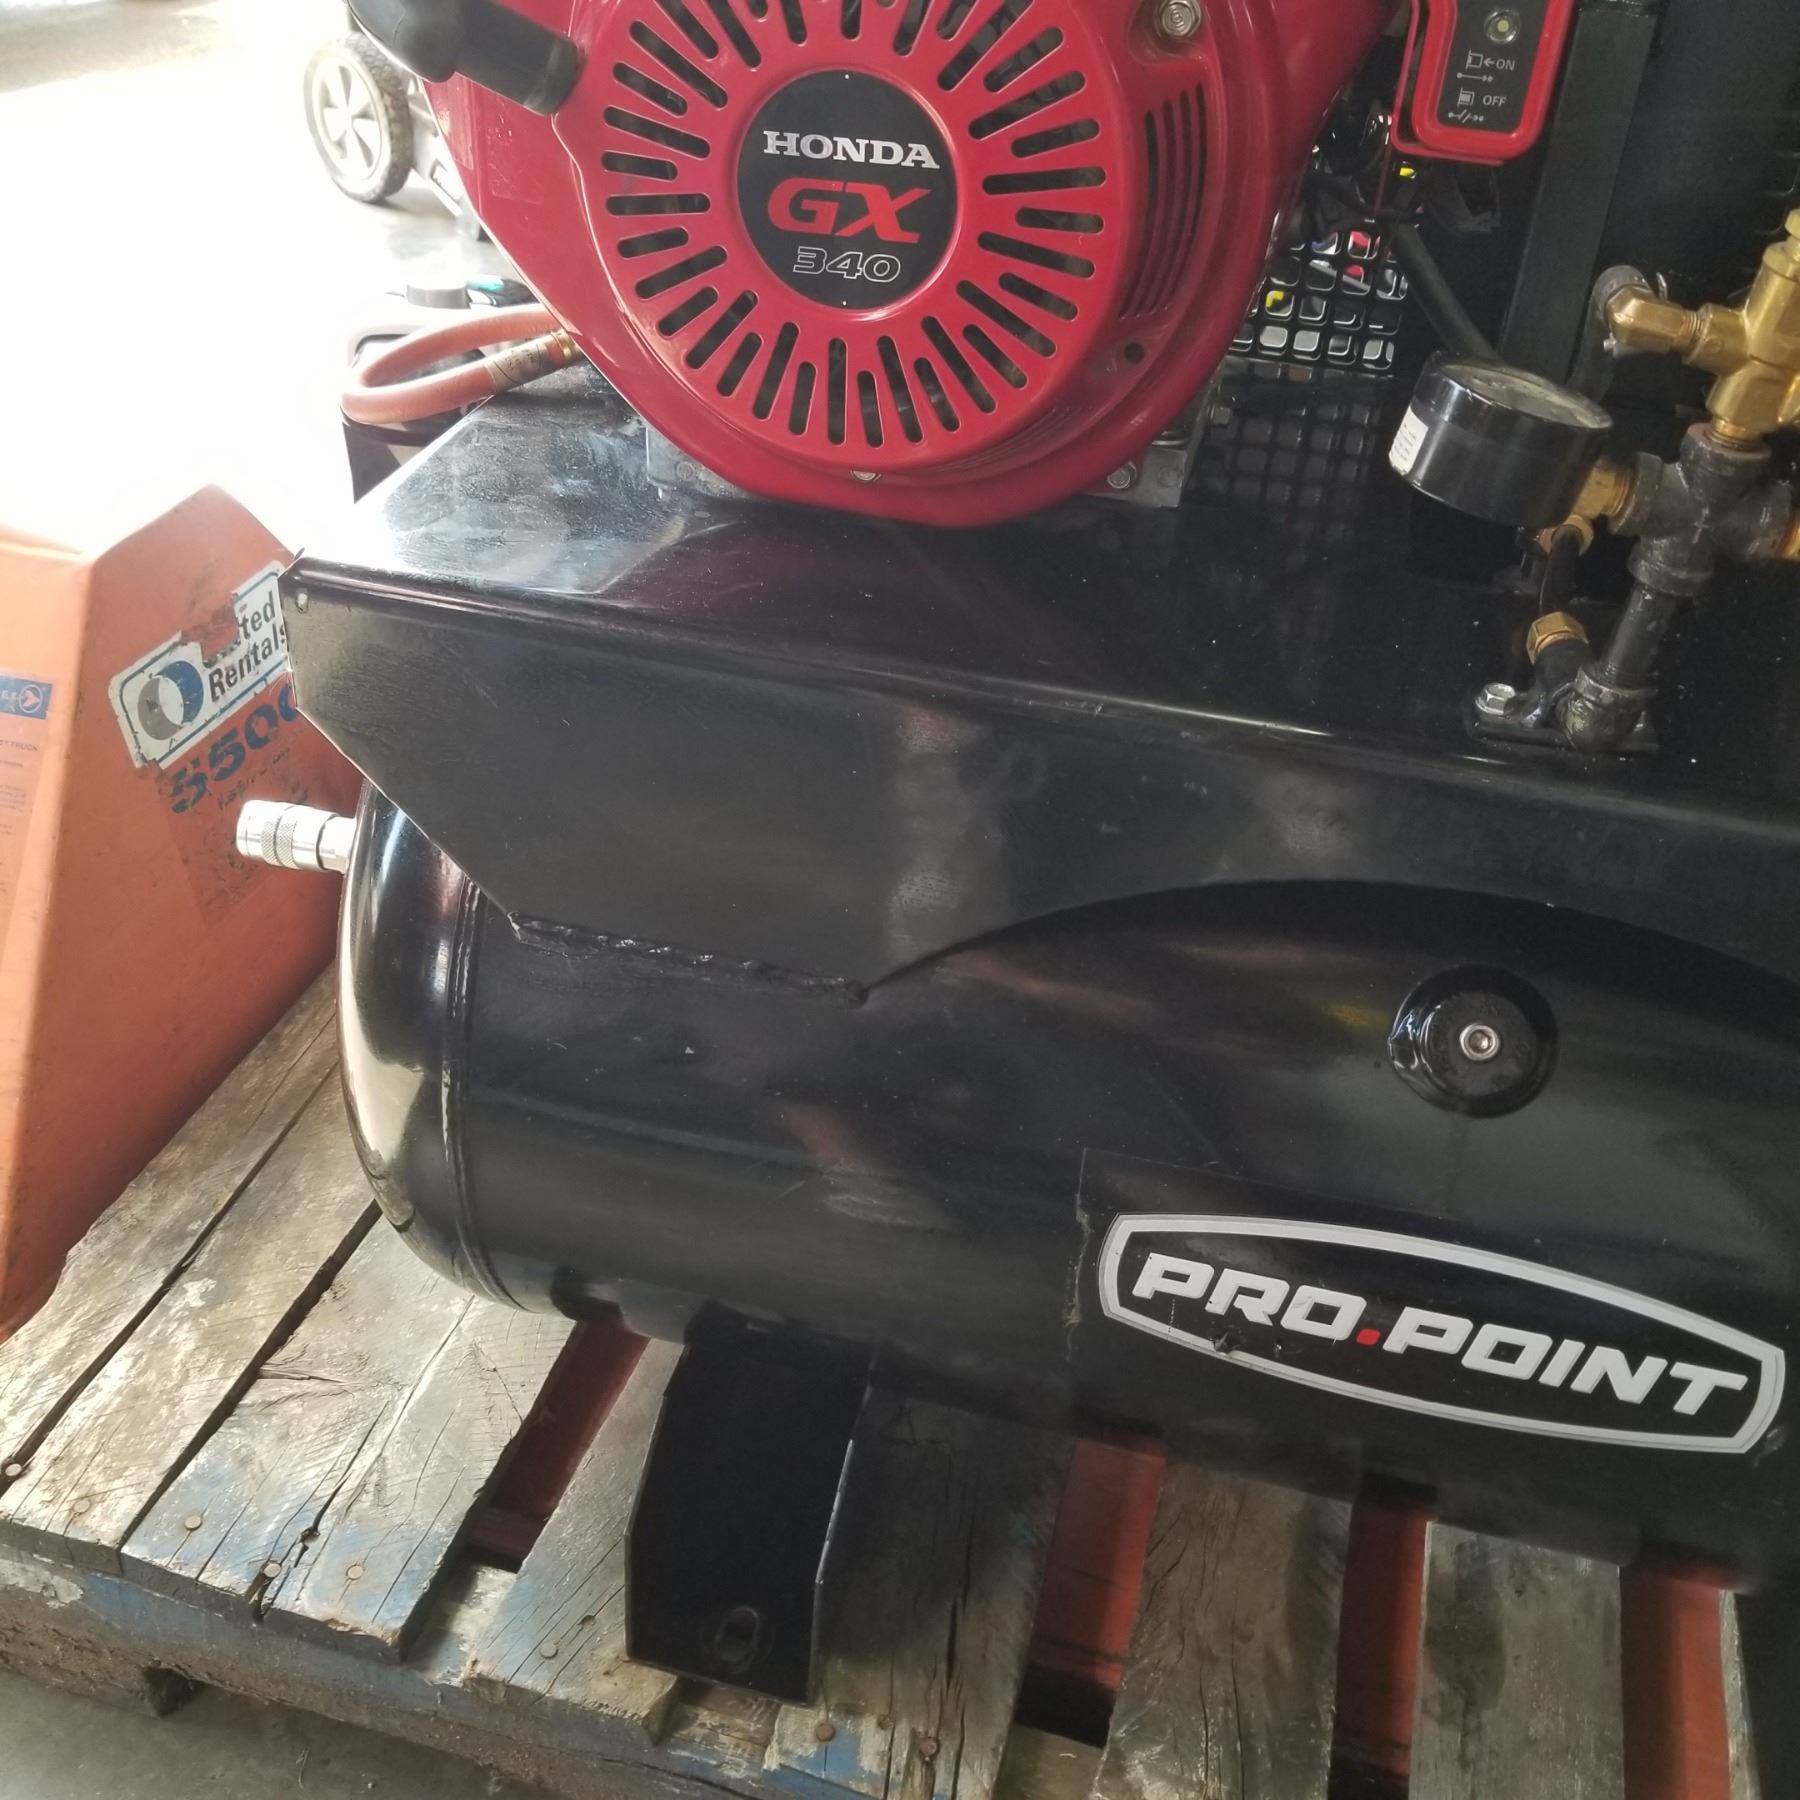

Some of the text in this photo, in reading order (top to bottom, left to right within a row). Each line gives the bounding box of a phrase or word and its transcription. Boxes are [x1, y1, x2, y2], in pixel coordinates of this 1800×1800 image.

[1496, 58, 1515, 71] ON
[1482, 95, 1506, 107] OFF
[763, 130, 940, 169] HONDA
[768, 177, 932, 244] GX
[793, 246, 901, 283] 340
